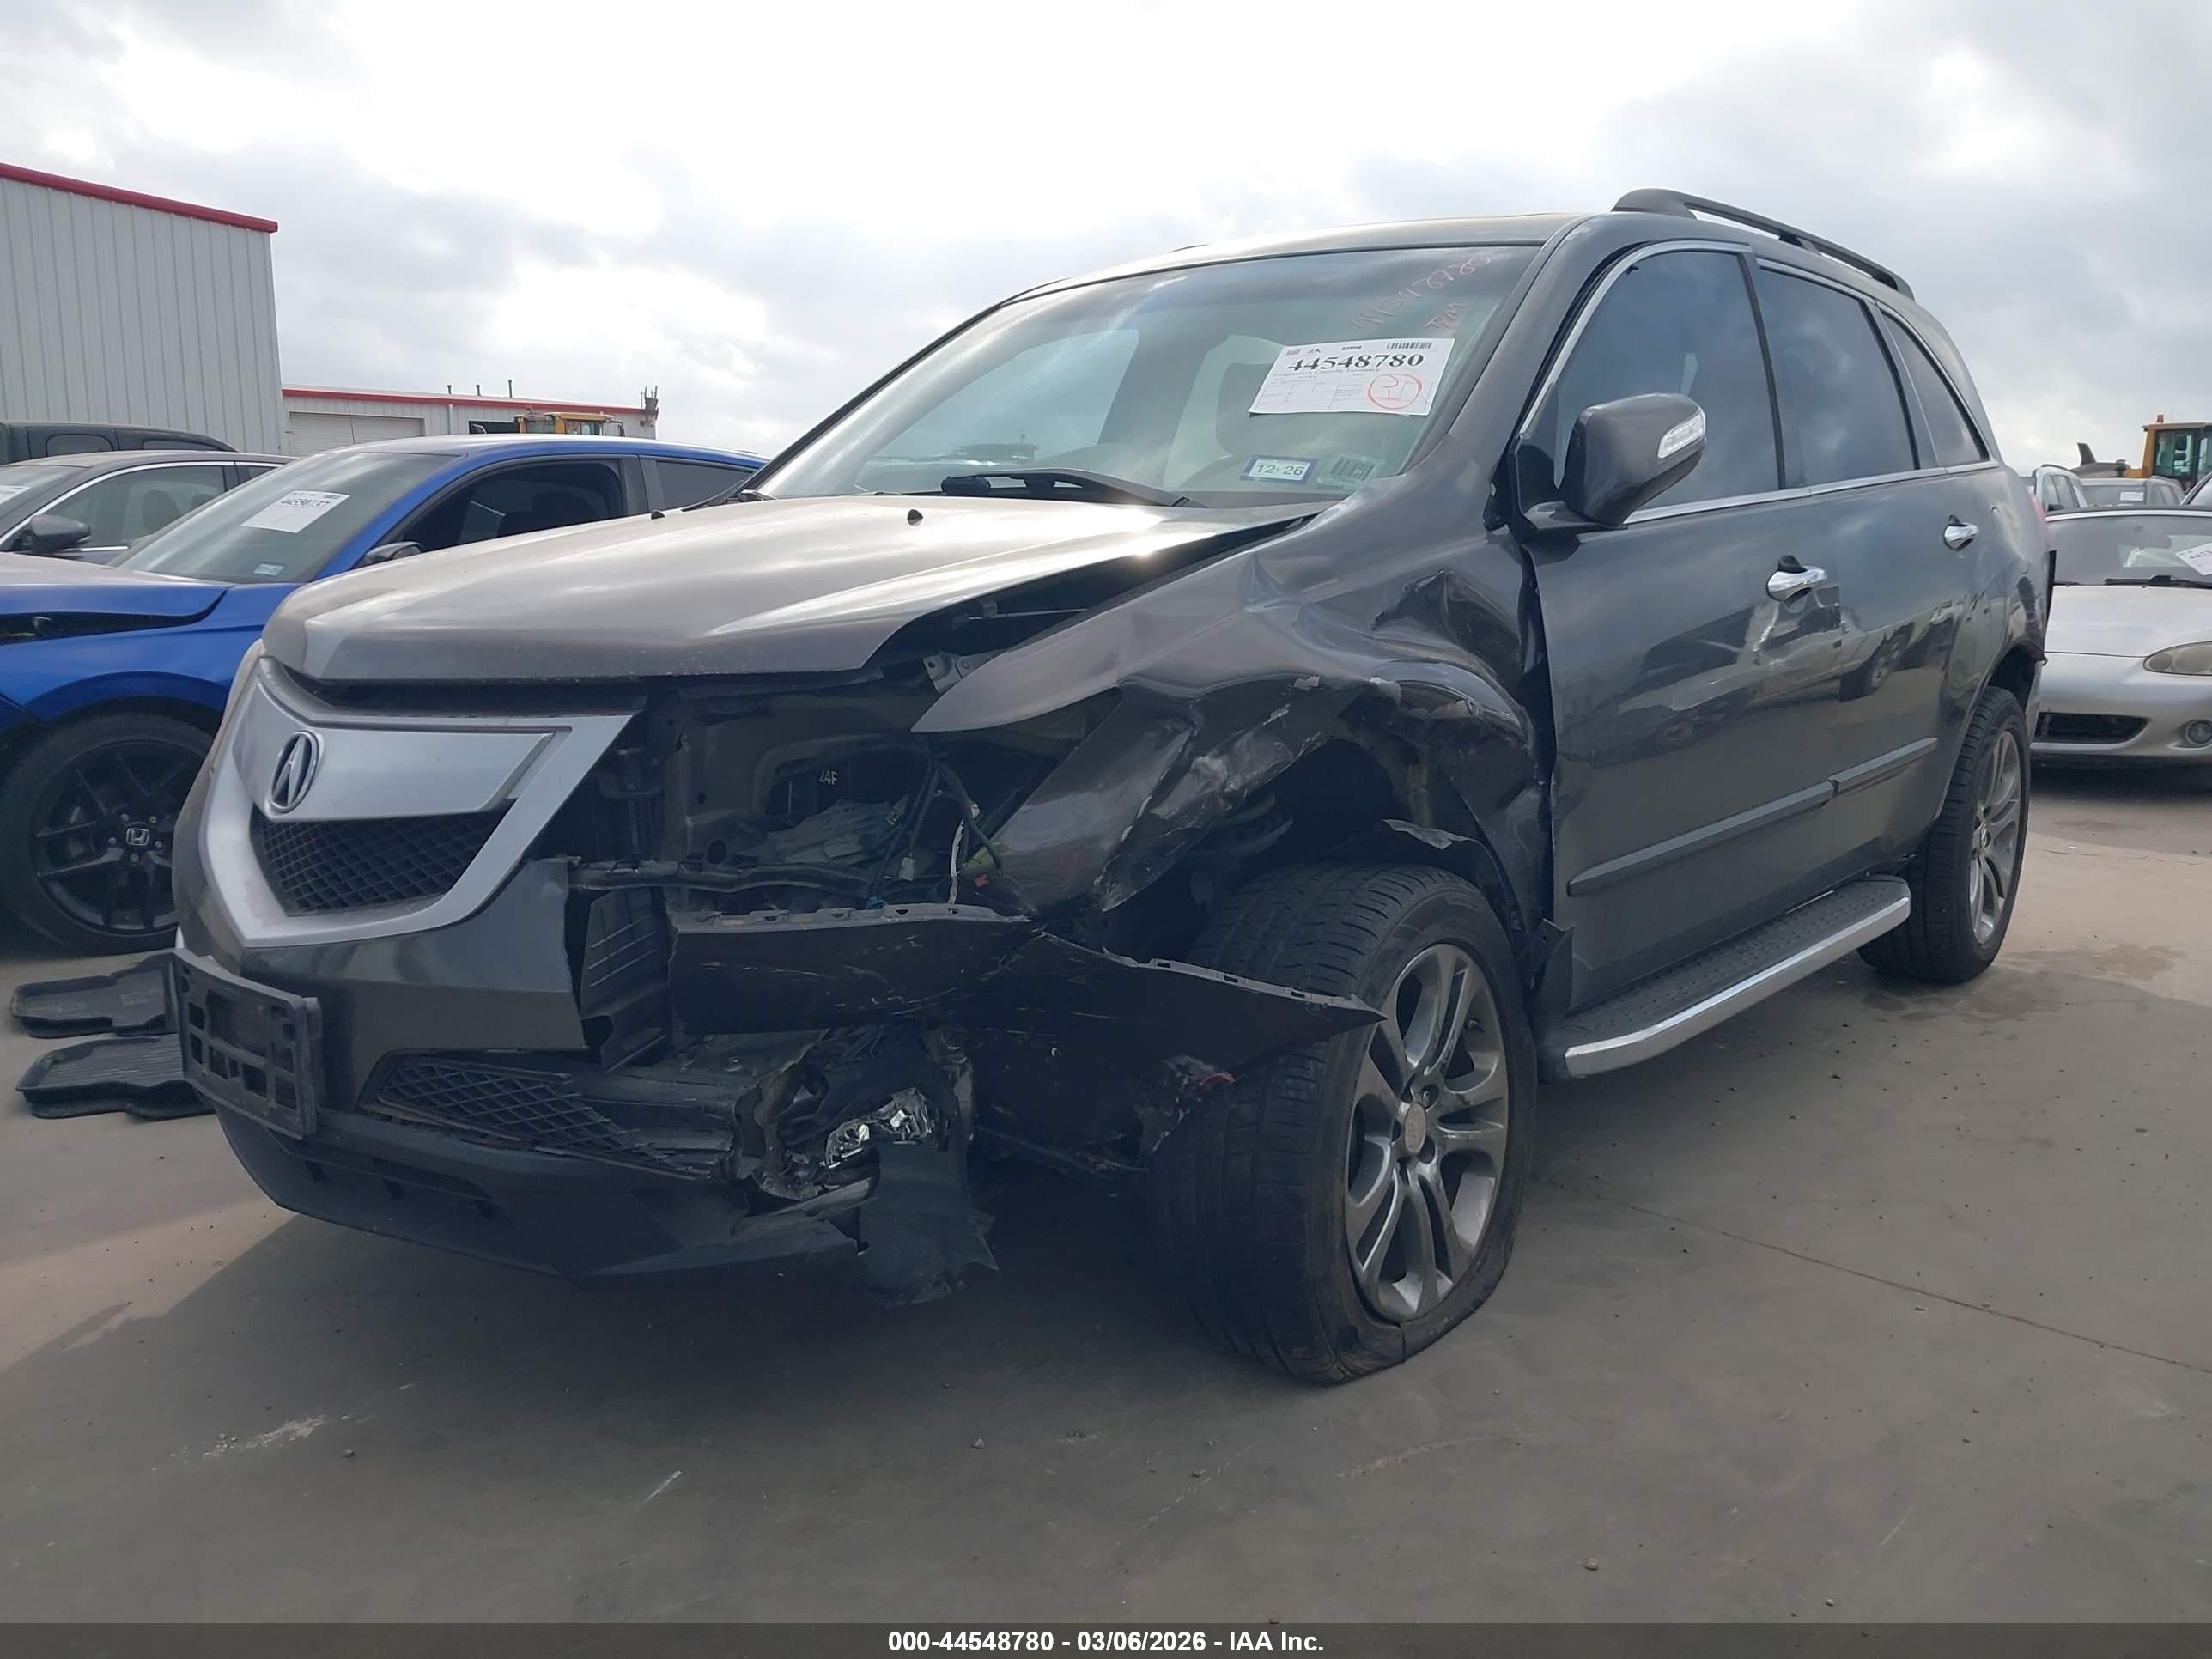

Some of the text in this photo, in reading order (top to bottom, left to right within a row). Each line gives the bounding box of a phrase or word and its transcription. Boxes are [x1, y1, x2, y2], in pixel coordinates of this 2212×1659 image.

[1287, 353, 1424, 371] 44548780
[1256, 464, 1305, 476] 12 26
